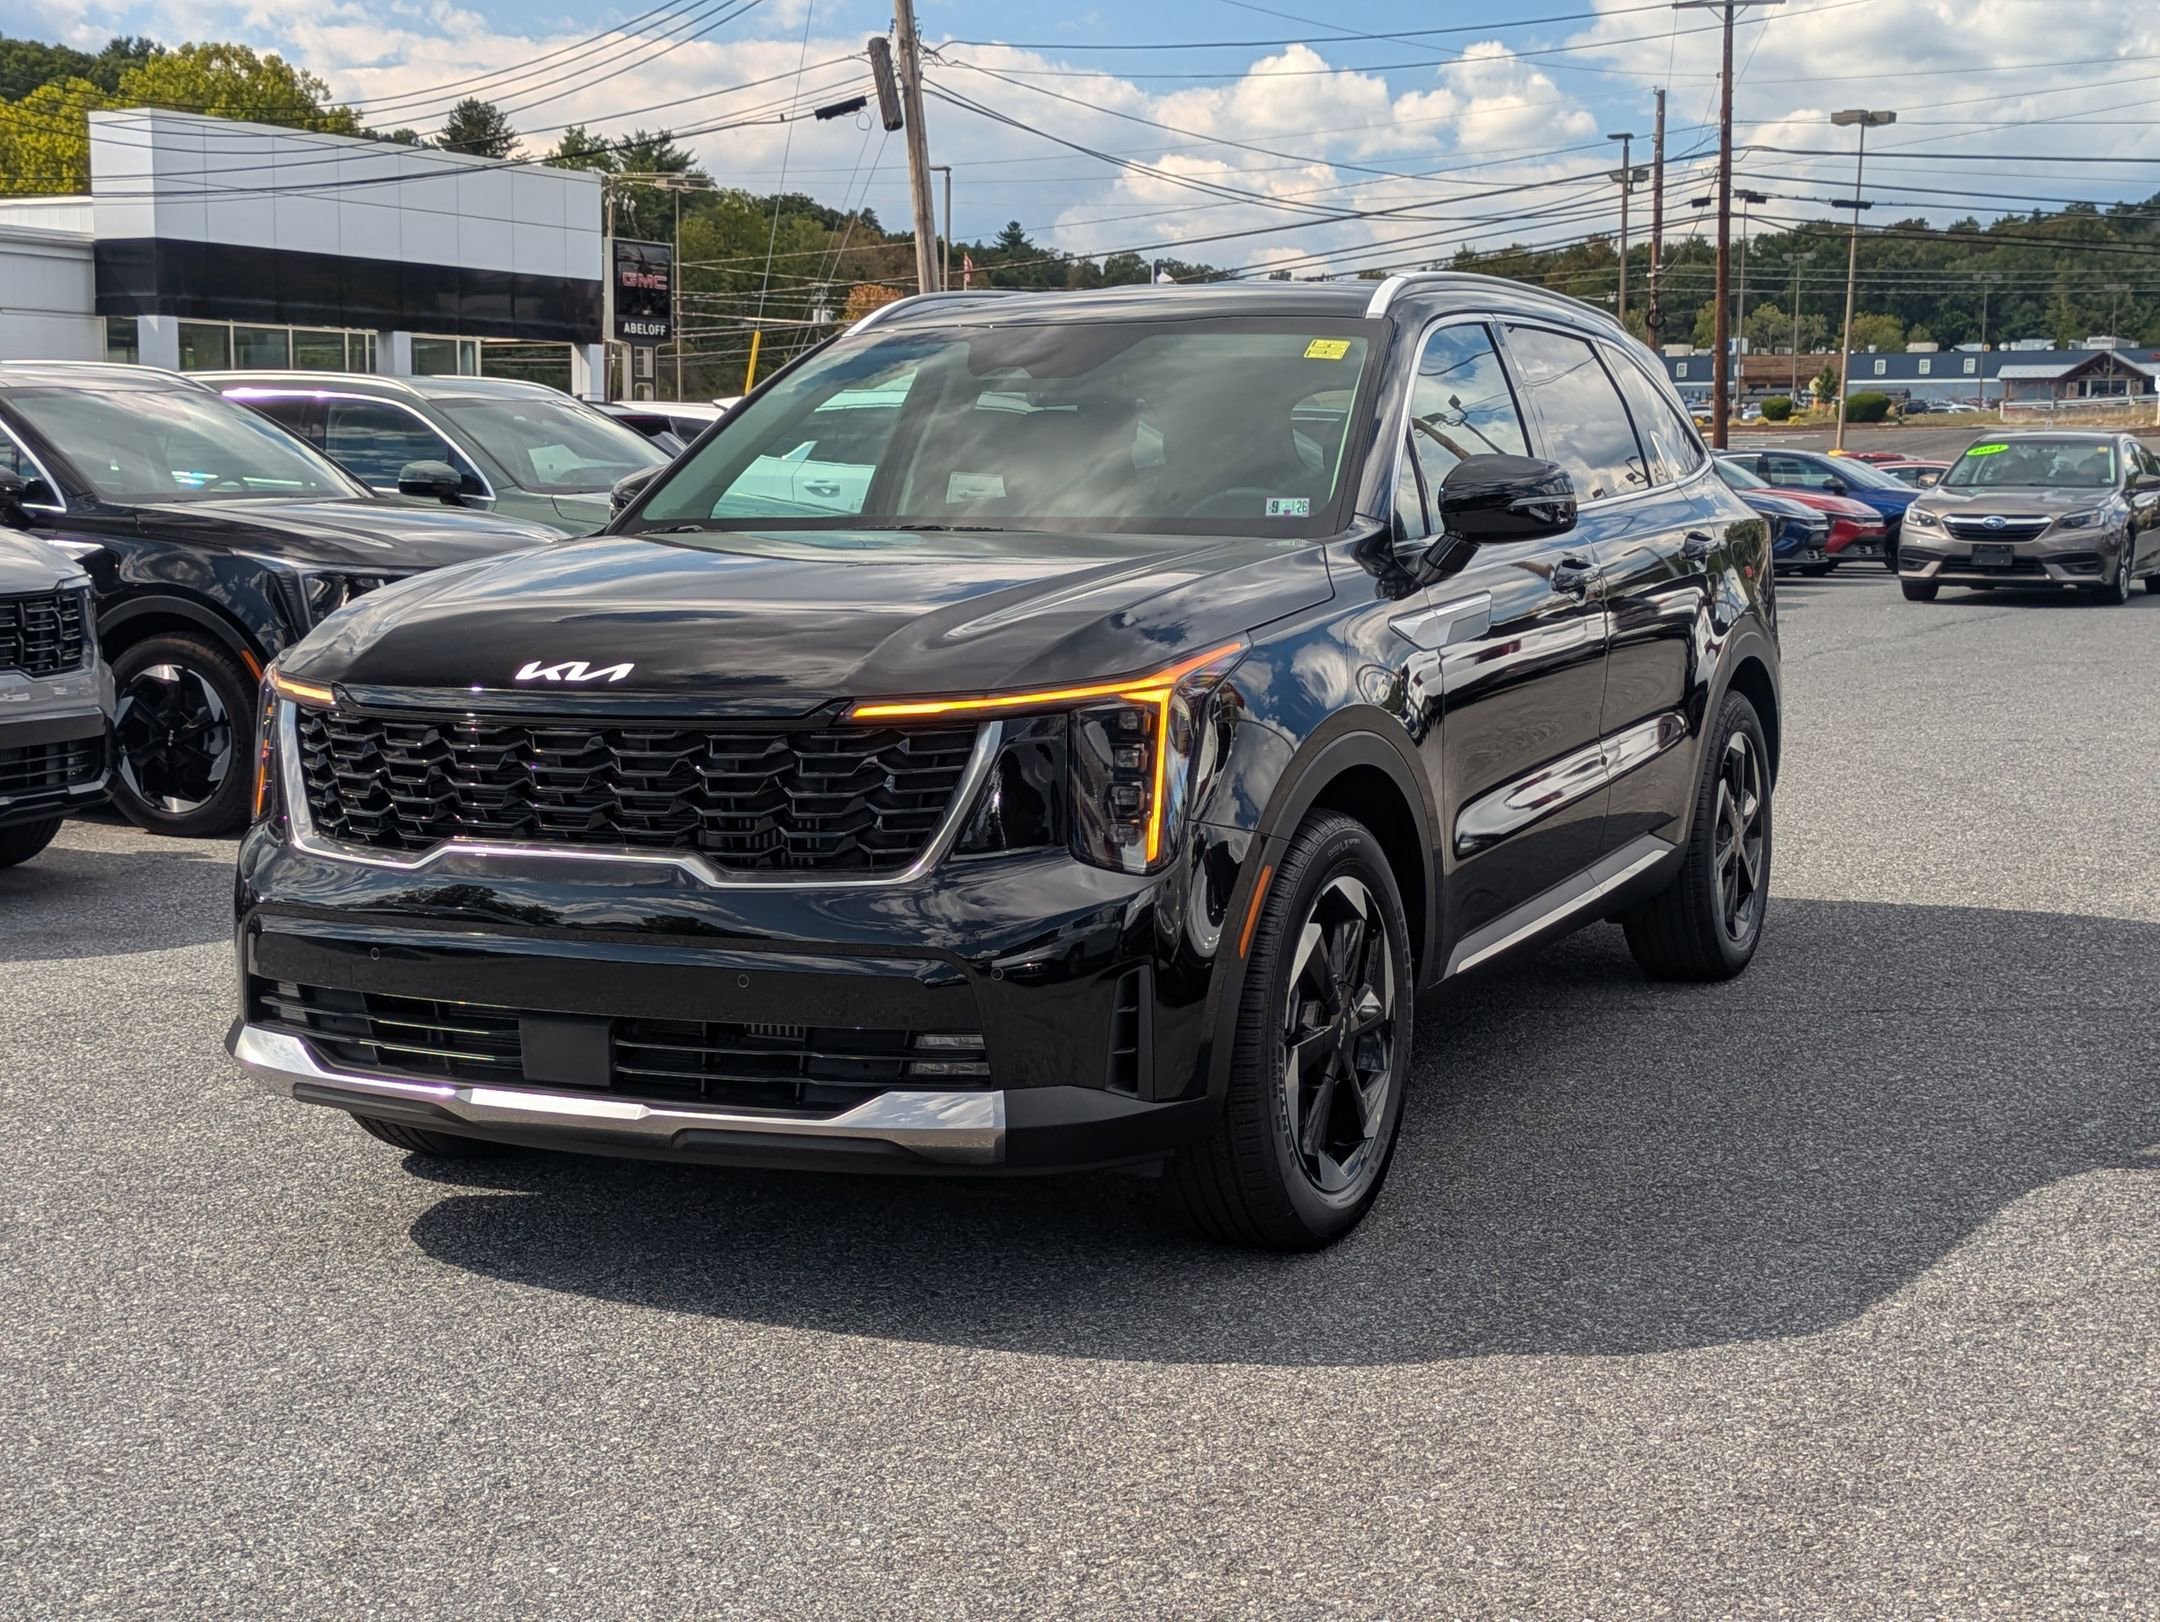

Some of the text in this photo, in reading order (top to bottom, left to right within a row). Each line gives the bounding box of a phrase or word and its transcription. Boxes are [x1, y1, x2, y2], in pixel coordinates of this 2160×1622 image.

[622, 272, 667, 290] GMC
[623, 322, 666, 336] ABELOFF
[515, 660, 635, 683] KIA
